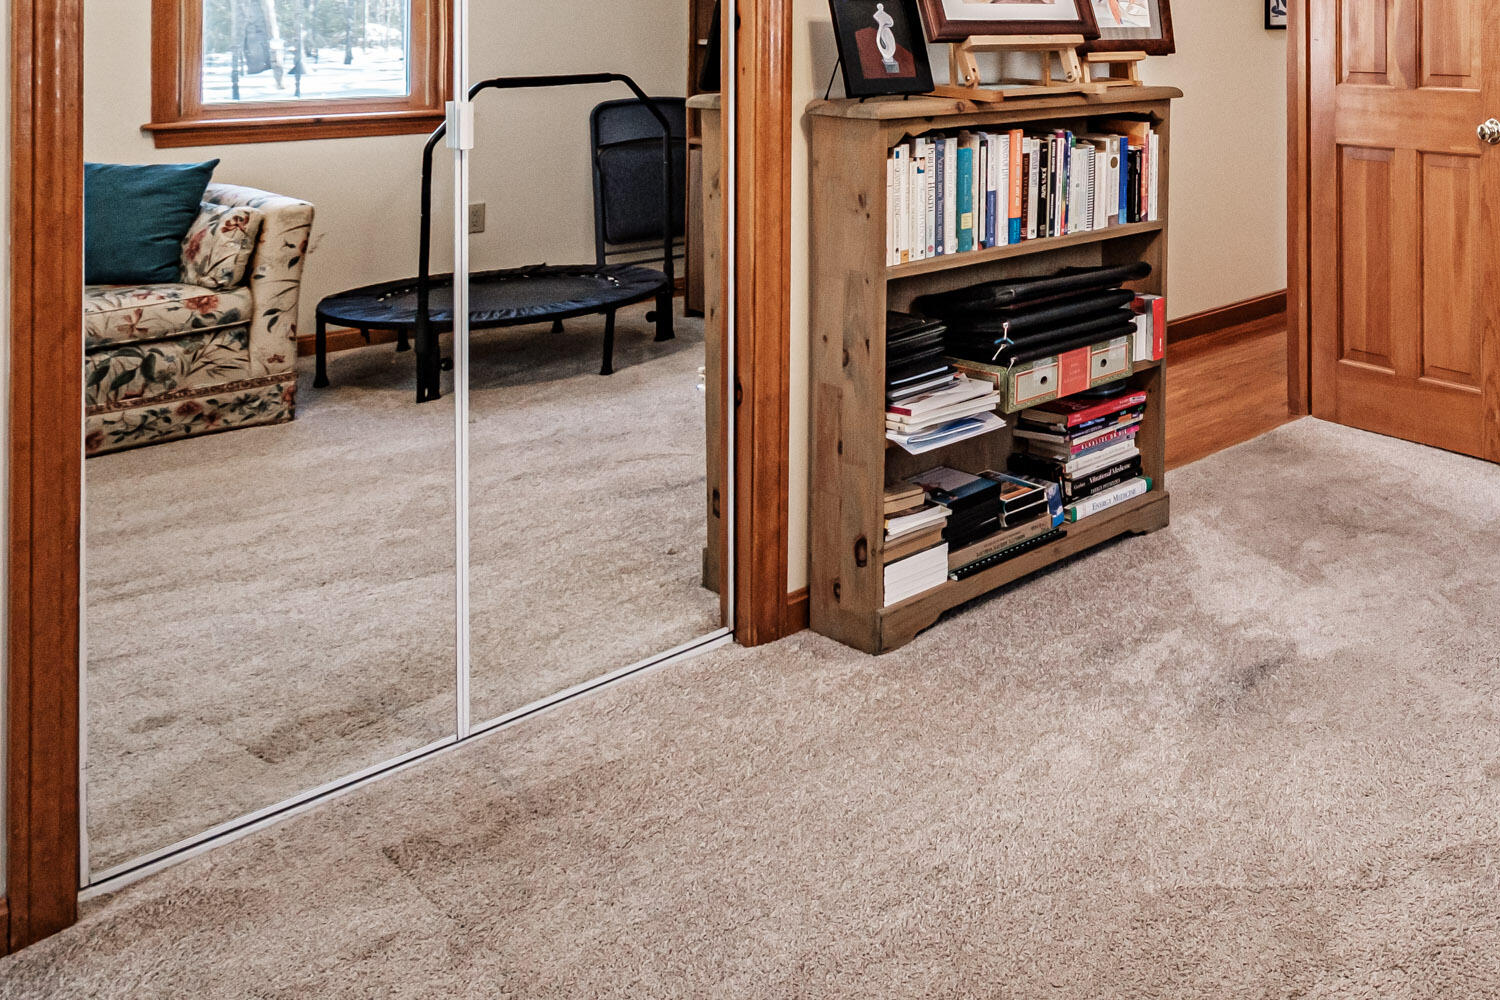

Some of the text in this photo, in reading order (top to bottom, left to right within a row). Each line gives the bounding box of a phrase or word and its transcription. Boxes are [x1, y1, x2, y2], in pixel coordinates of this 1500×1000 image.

[1040, 167, 1048, 199] JOY'S WAY
[1089, 469, 1112, 484] Vibrational
[1112, 463, 1131, 476] Medicine
[1092, 487, 1137, 512] ENERGY MEDICINE
